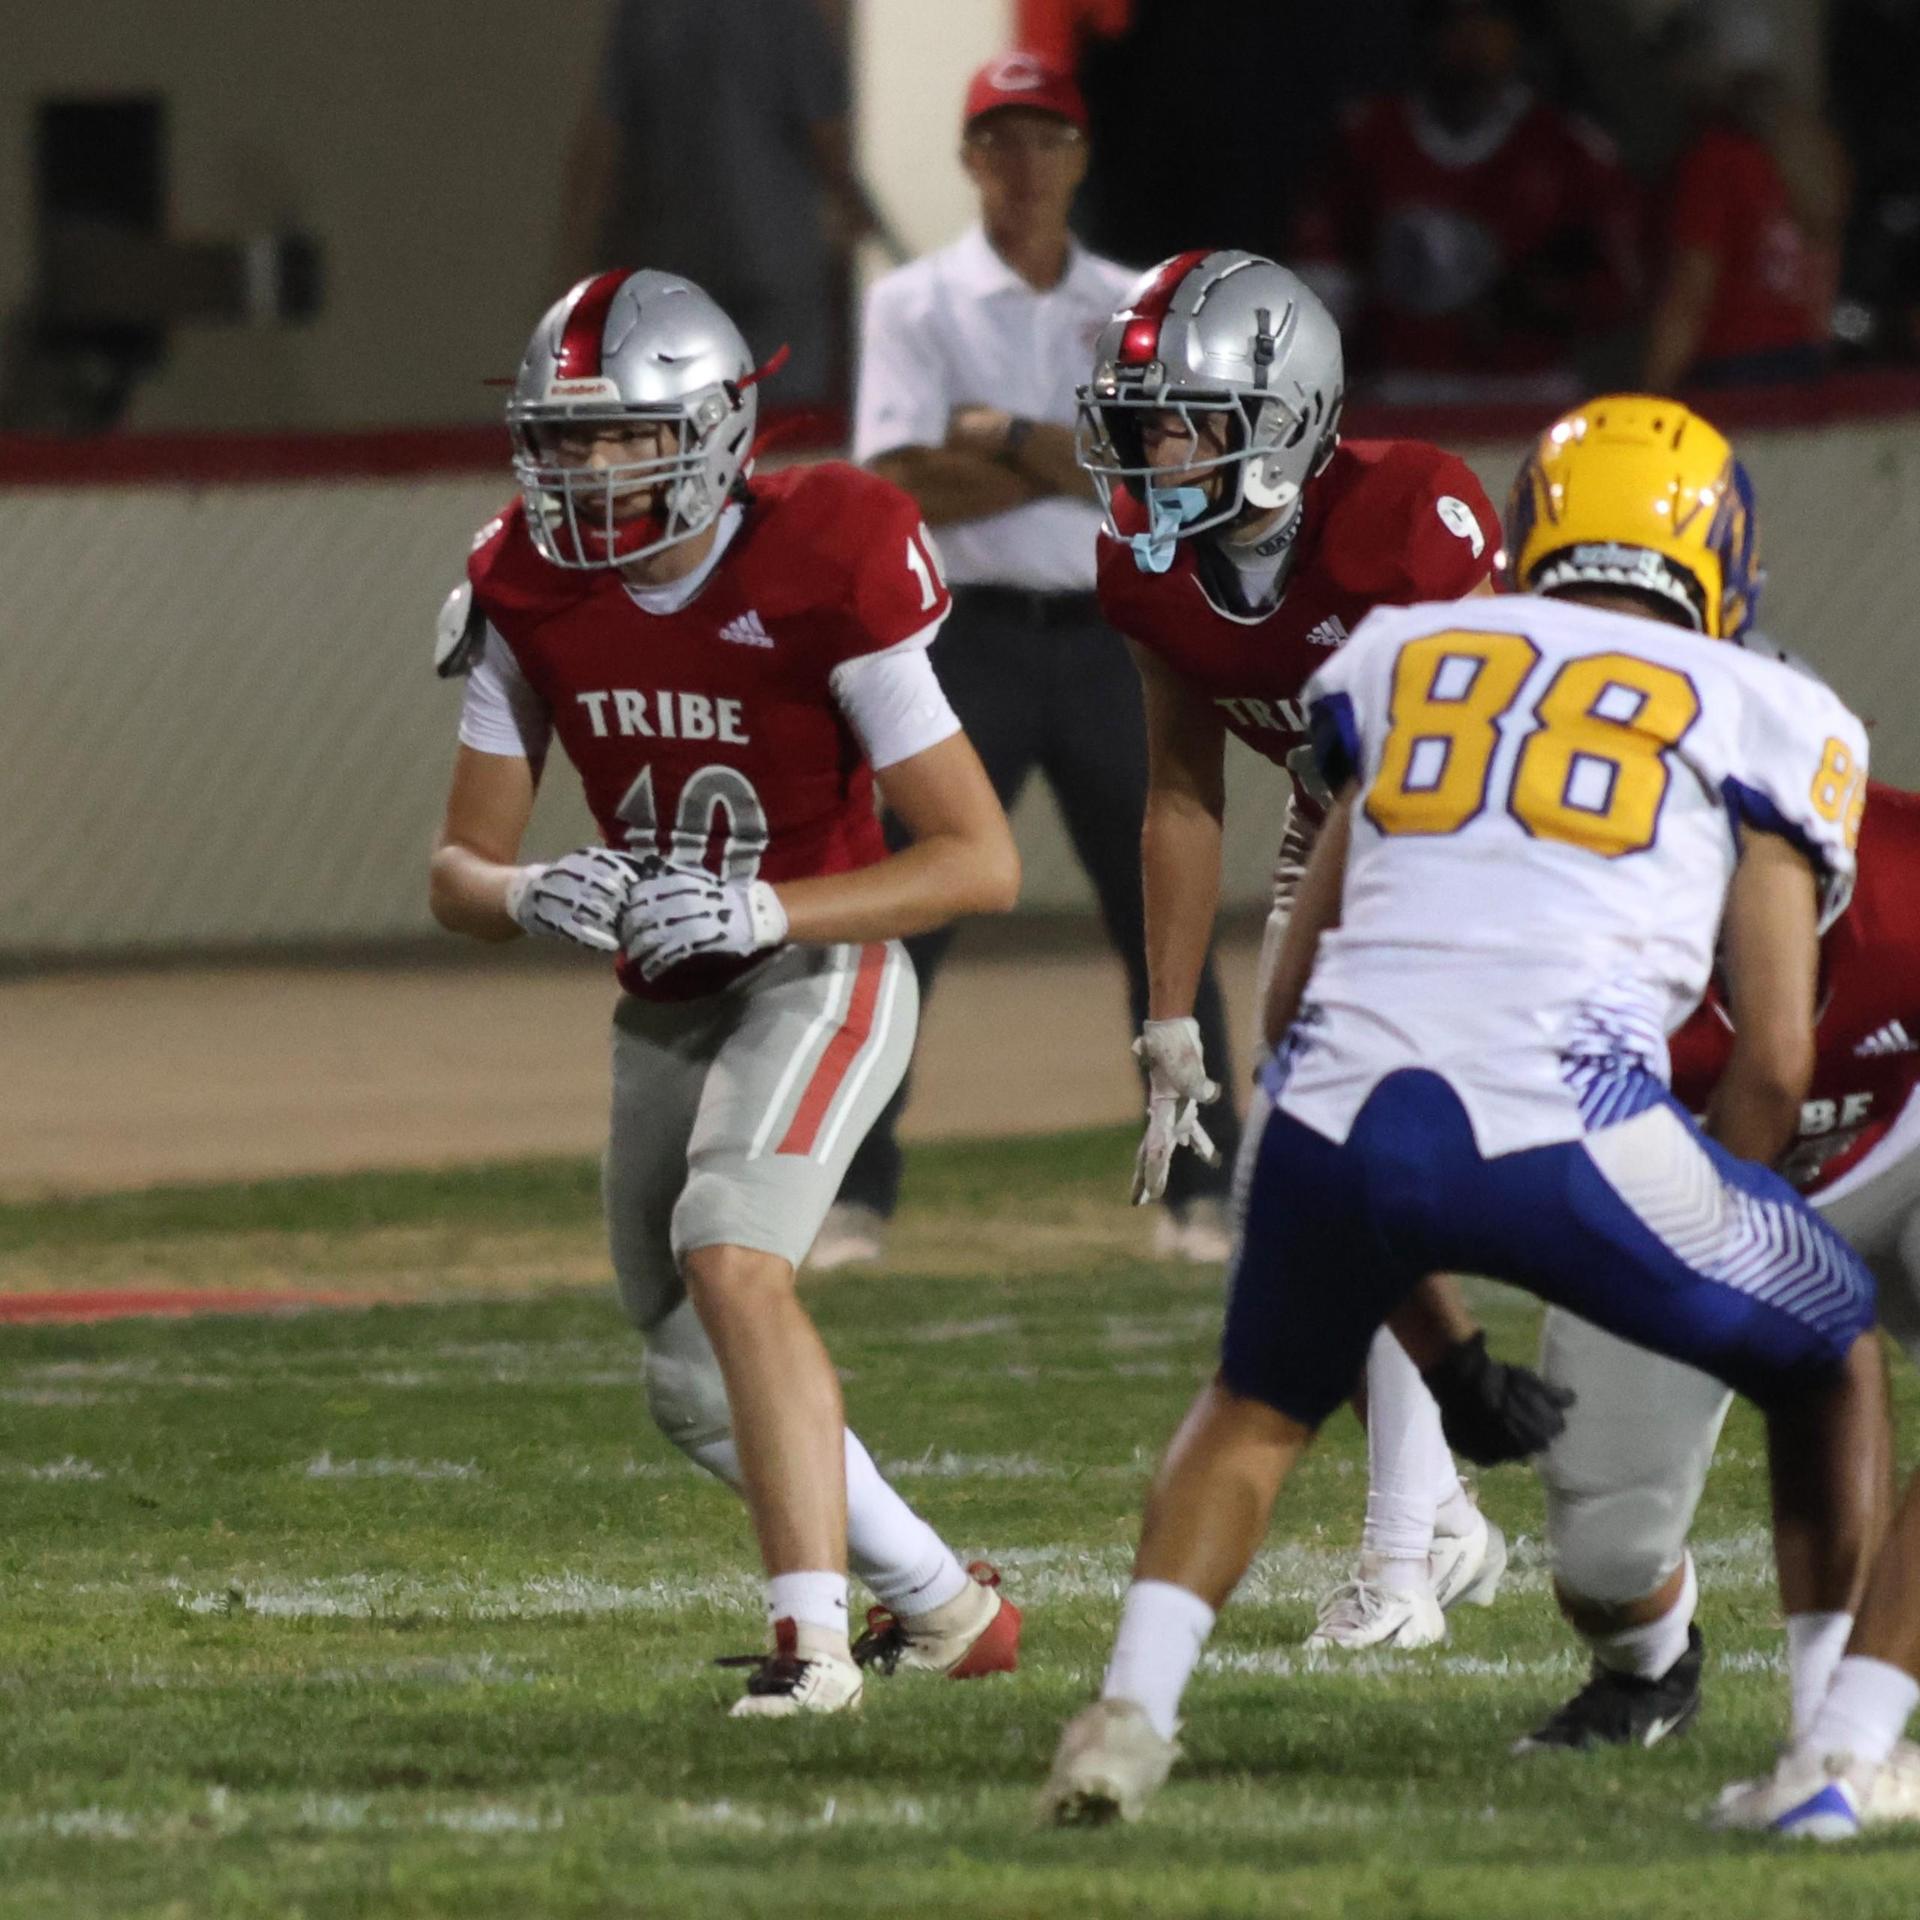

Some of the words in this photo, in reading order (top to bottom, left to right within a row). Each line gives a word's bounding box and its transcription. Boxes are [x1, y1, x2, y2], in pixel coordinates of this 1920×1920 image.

[1437, 495, 1485, 559] 9
[576, 688, 751, 745] TRIBE
[1363, 628, 1703, 860] 88
[614, 763, 769, 882] 10
